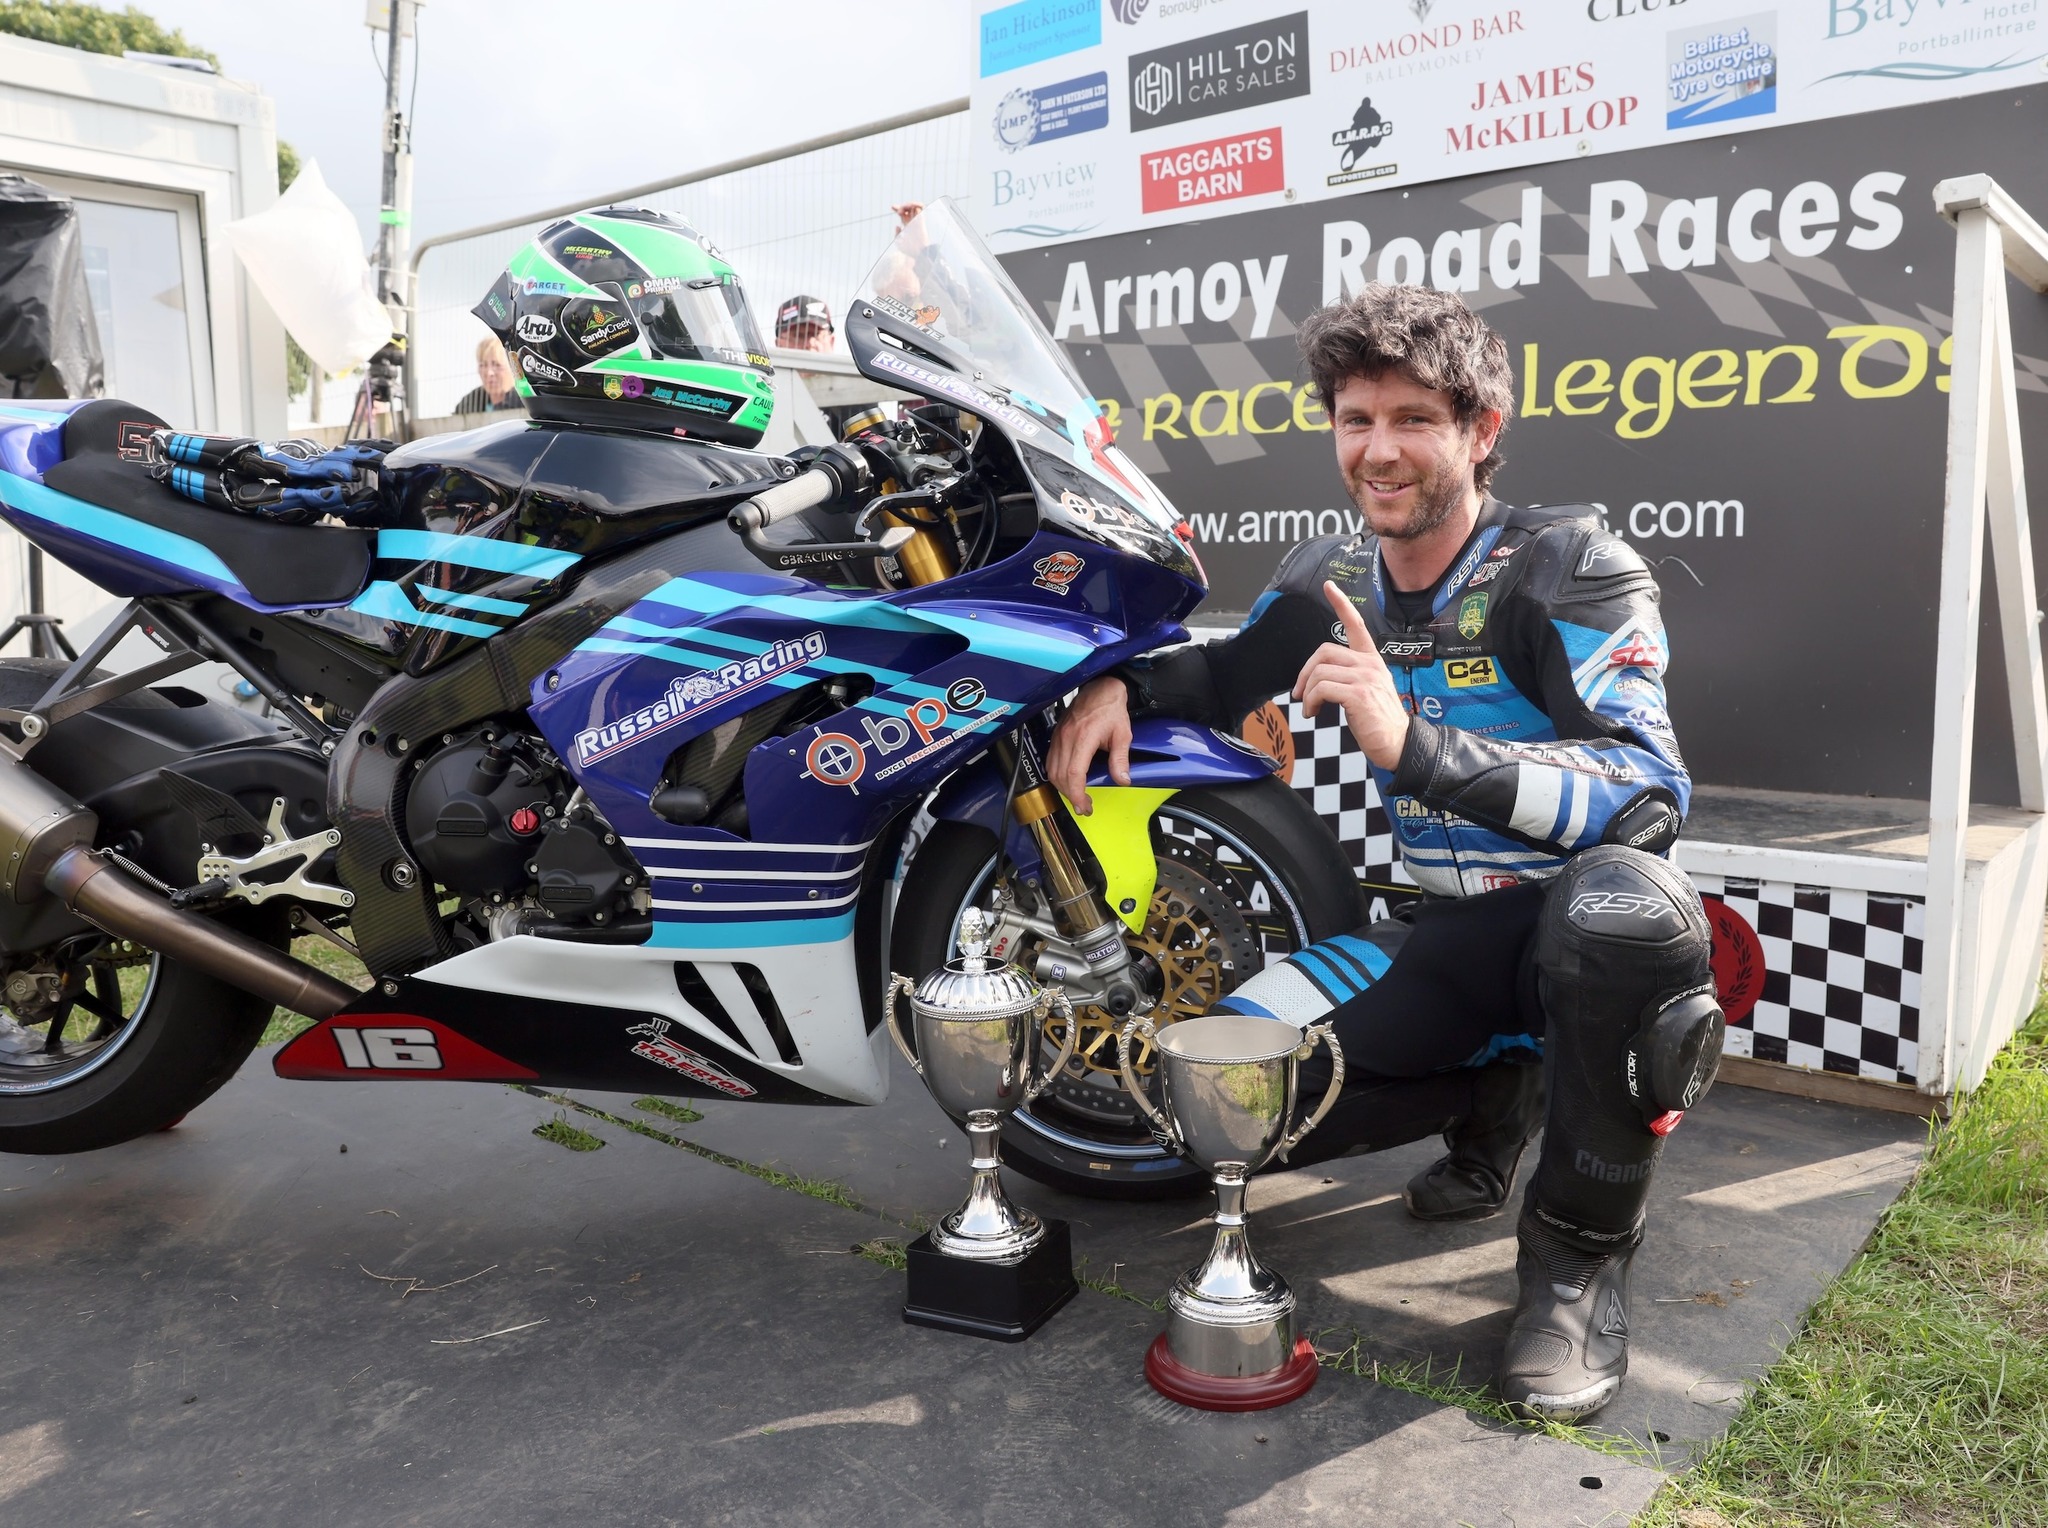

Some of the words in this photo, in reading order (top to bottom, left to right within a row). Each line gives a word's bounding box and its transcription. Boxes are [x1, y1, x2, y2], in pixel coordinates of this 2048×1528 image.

[984, 26, 1007, 44] Ian
[1013, 0, 1096, 35] Hickinson
[1983, 0, 2038, 20] Hotel
[1330, 24, 1463, 73] DIAMOND
[1472, 10, 1526, 41] BAR
[1684, 27, 1749, 60] Belfast
[1898, 19, 2038, 55] Portballintrae
[1188, 32, 1297, 80] HILTON
[1670, 42, 1773, 80] Motorcycle
[1188, 82, 1228, 103] CAR
[1236, 64, 1297, 90] SALES
[1471, 62, 1596, 111] JAMES
[1669, 79, 1708, 102] Tyre
[1712, 61, 1773, 88] Centre
[1001, 115, 1028, 130] JMP
[1333, 122, 1391, 145] A.M.R.R.C
[1445, 96, 1639, 155] McKILLOP
[1148, 137, 1273, 180] TAGGARTS
[1376, 165, 1396, 176] CLUB
[992, 161, 1097, 206] Bayview
[1178, 171, 1243, 202] BARN
[1055, 254, 1289, 340] Armoy
[1323, 186, 1542, 307] Road
[1588, 171, 1907, 278] Races
[527, 281, 566, 291] TARGET
[516, 316, 554, 337] Arai
[580, 317, 632, 345] SandyCreek
[535, 361, 564, 379] CASEY
[652, 387, 674, 399] Jas
[676, 391, 732, 411] McCarthy
[874, 350, 951, 390] Russell
[976, 392, 1039, 437] Racing
[780, 550, 843, 566] GBRACING
[1037, 559, 1082, 577] Vinyl
[1448, 540, 1483, 598] RST
[1380, 641, 1433, 656] RST
[1448, 659, 1492, 679] C4
[1470, 676, 1490, 685] ENERGY
[578, 684, 686, 759] Russell
[722, 632, 825, 688] Racing
[876, 760, 905, 780] BOYCE
[905, 736, 953, 765] PRECISION
[953, 705, 1010, 739] ENGINEERING
[1487, 742, 1554, 759] Russell
[1572, 755, 1632, 781] Racing
[1629, 815, 1670, 846] RST
[1568, 892, 1677, 919] RST
[1085, 943, 1118, 960] MAXTON
[332, 1027, 445, 1069] 16
[638, 1042, 754, 1096] TOLERTON
